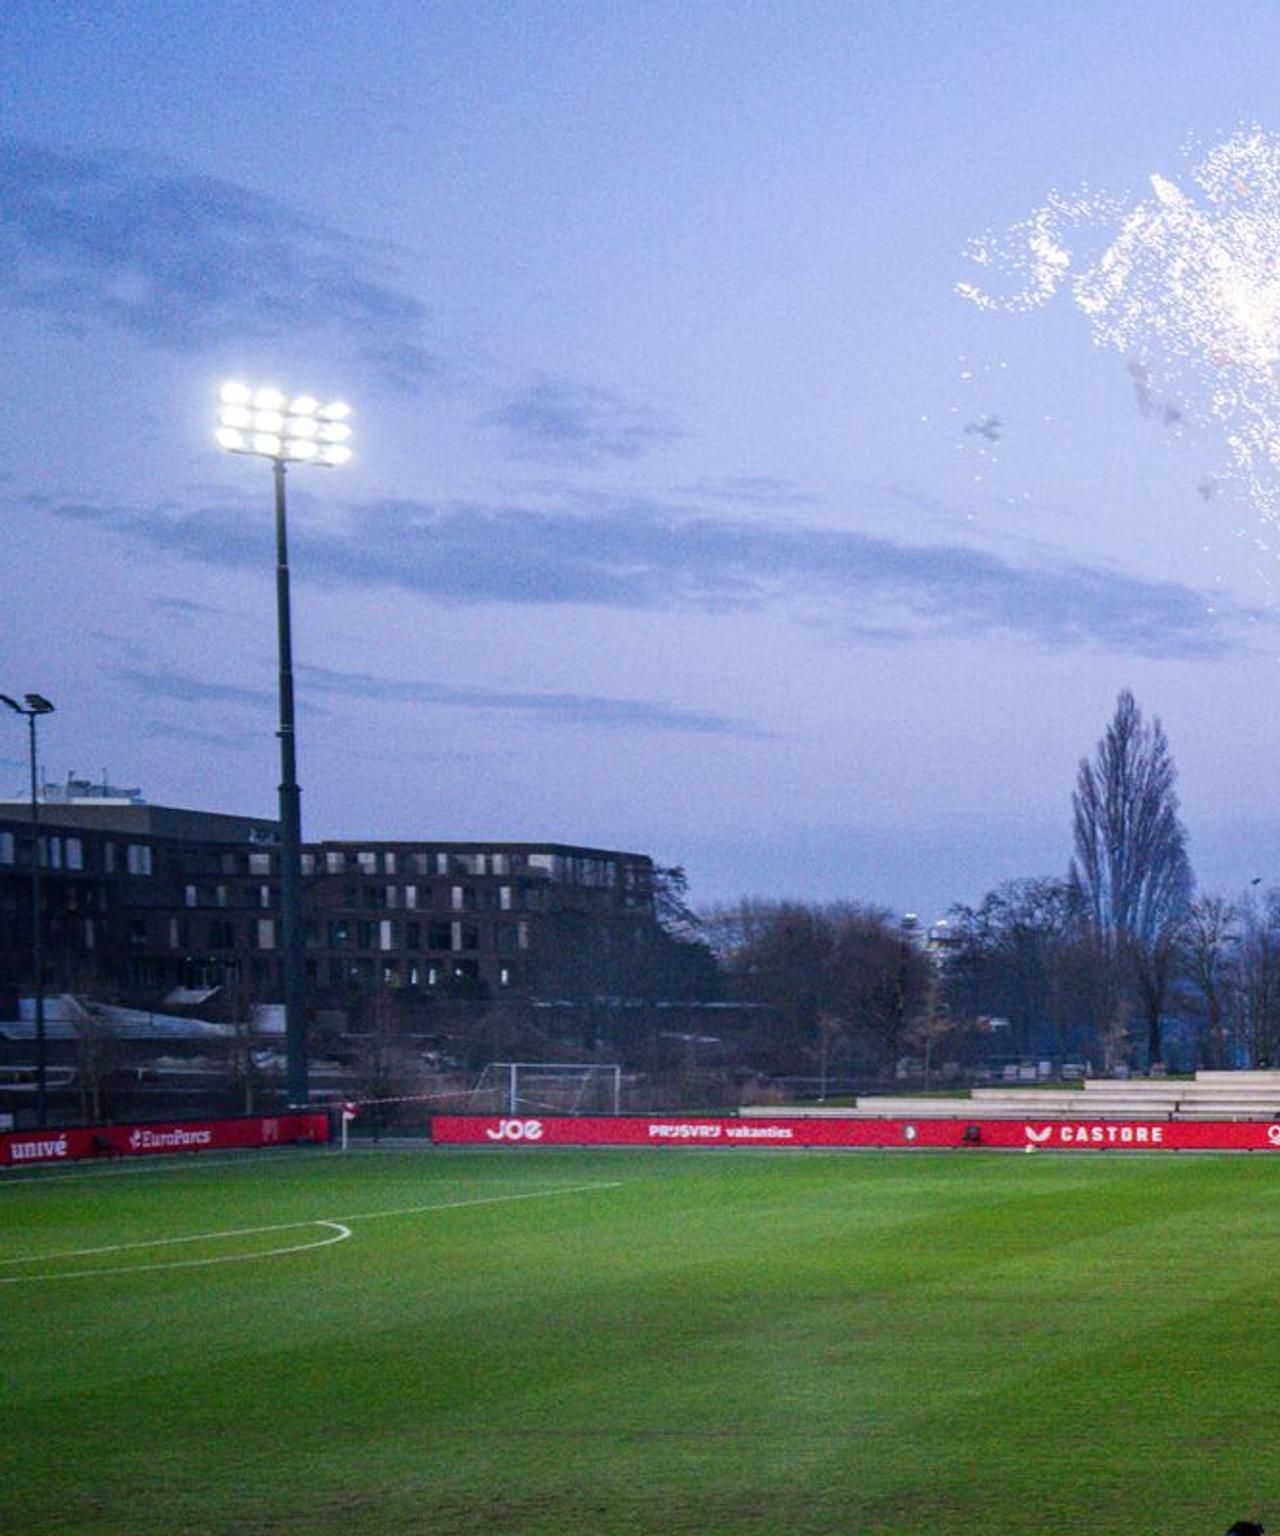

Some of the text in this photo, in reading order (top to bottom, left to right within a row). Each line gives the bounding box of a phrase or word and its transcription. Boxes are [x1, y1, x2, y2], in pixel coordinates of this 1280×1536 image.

[486, 1120, 543, 1140] JOE
[726, 1126, 792, 1138] vakanties
[1061, 1127, 1162, 1142] CASTORE
[11, 1134, 67, 1160] univé
